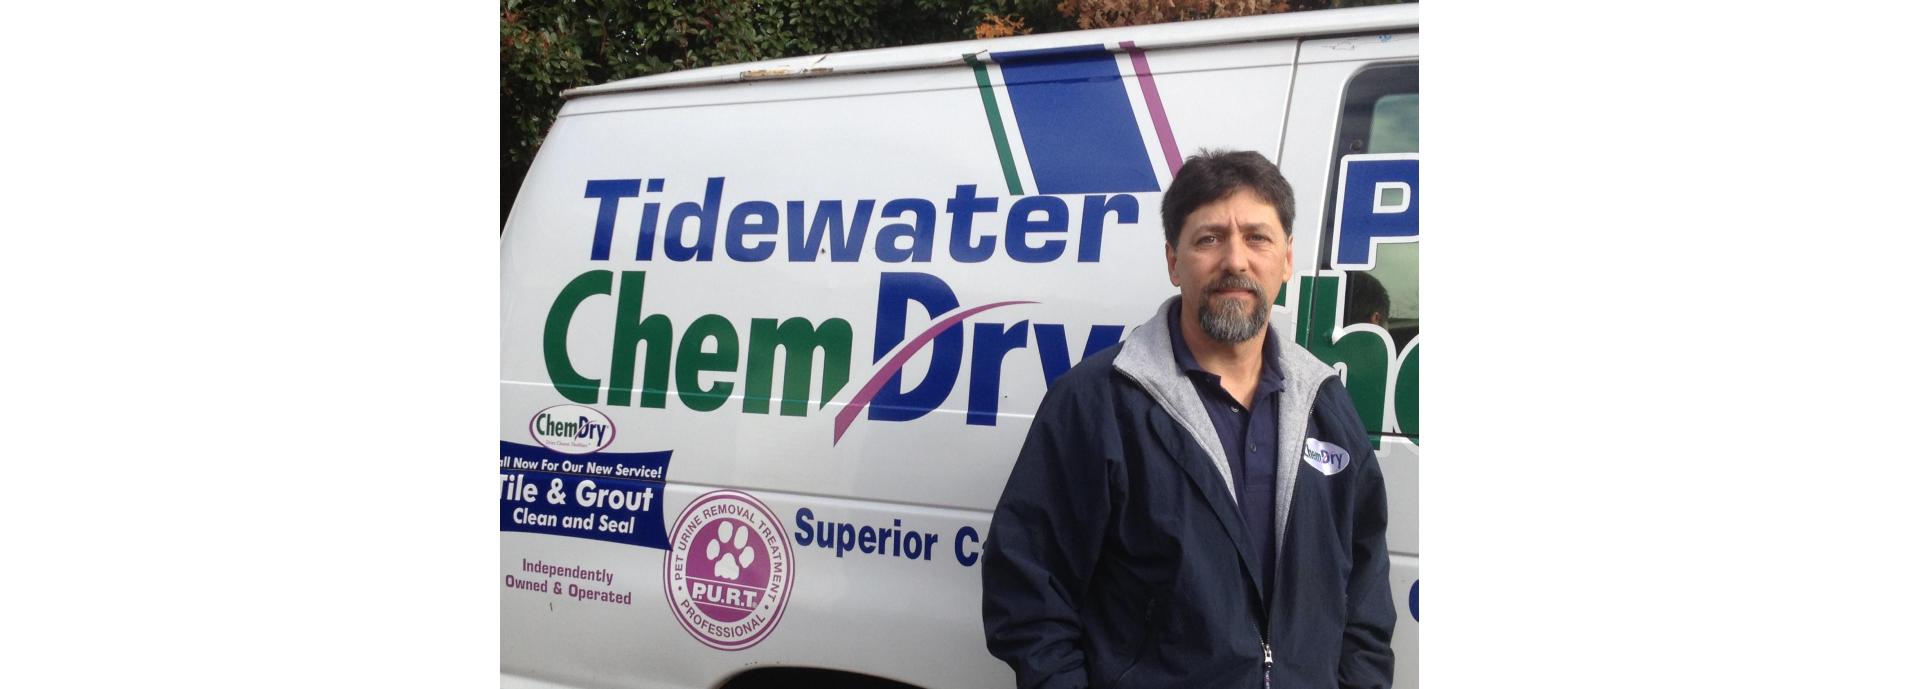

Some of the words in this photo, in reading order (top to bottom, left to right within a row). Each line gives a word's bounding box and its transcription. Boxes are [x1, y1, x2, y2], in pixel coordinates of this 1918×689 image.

[584, 177, 1139, 263] Tidewater
[535, 413, 606, 447] ChemDry
[513, 457, 539, 470] Now
[541, 459, 559, 472] For
[562, 460, 583, 473] Our
[586, 462, 613, 475] New
[615, 464, 662, 478] Service!
[500, 474, 538, 502] Tile
[546, 477, 566, 505] &
[576, 479, 653, 512] Grout
[513, 507, 557, 526] Clean
[562, 513, 594, 530] and
[598, 515, 635, 534] Seal
[794, 507, 938, 561] Superior
[954, 526, 986, 567] C
[674, 555, 684, 581] PET
[681, 515, 703, 551] URINE
[703, 504, 756, 524] REMOVAL
[758, 520, 783, 603] TREATMENT
[505, 574, 548, 593] Owned
[553, 581, 563, 595] &
[568, 583, 632, 605] Operated
[522, 558, 614, 586] Independently
[681, 599, 766, 638] PROFESSIONAL
